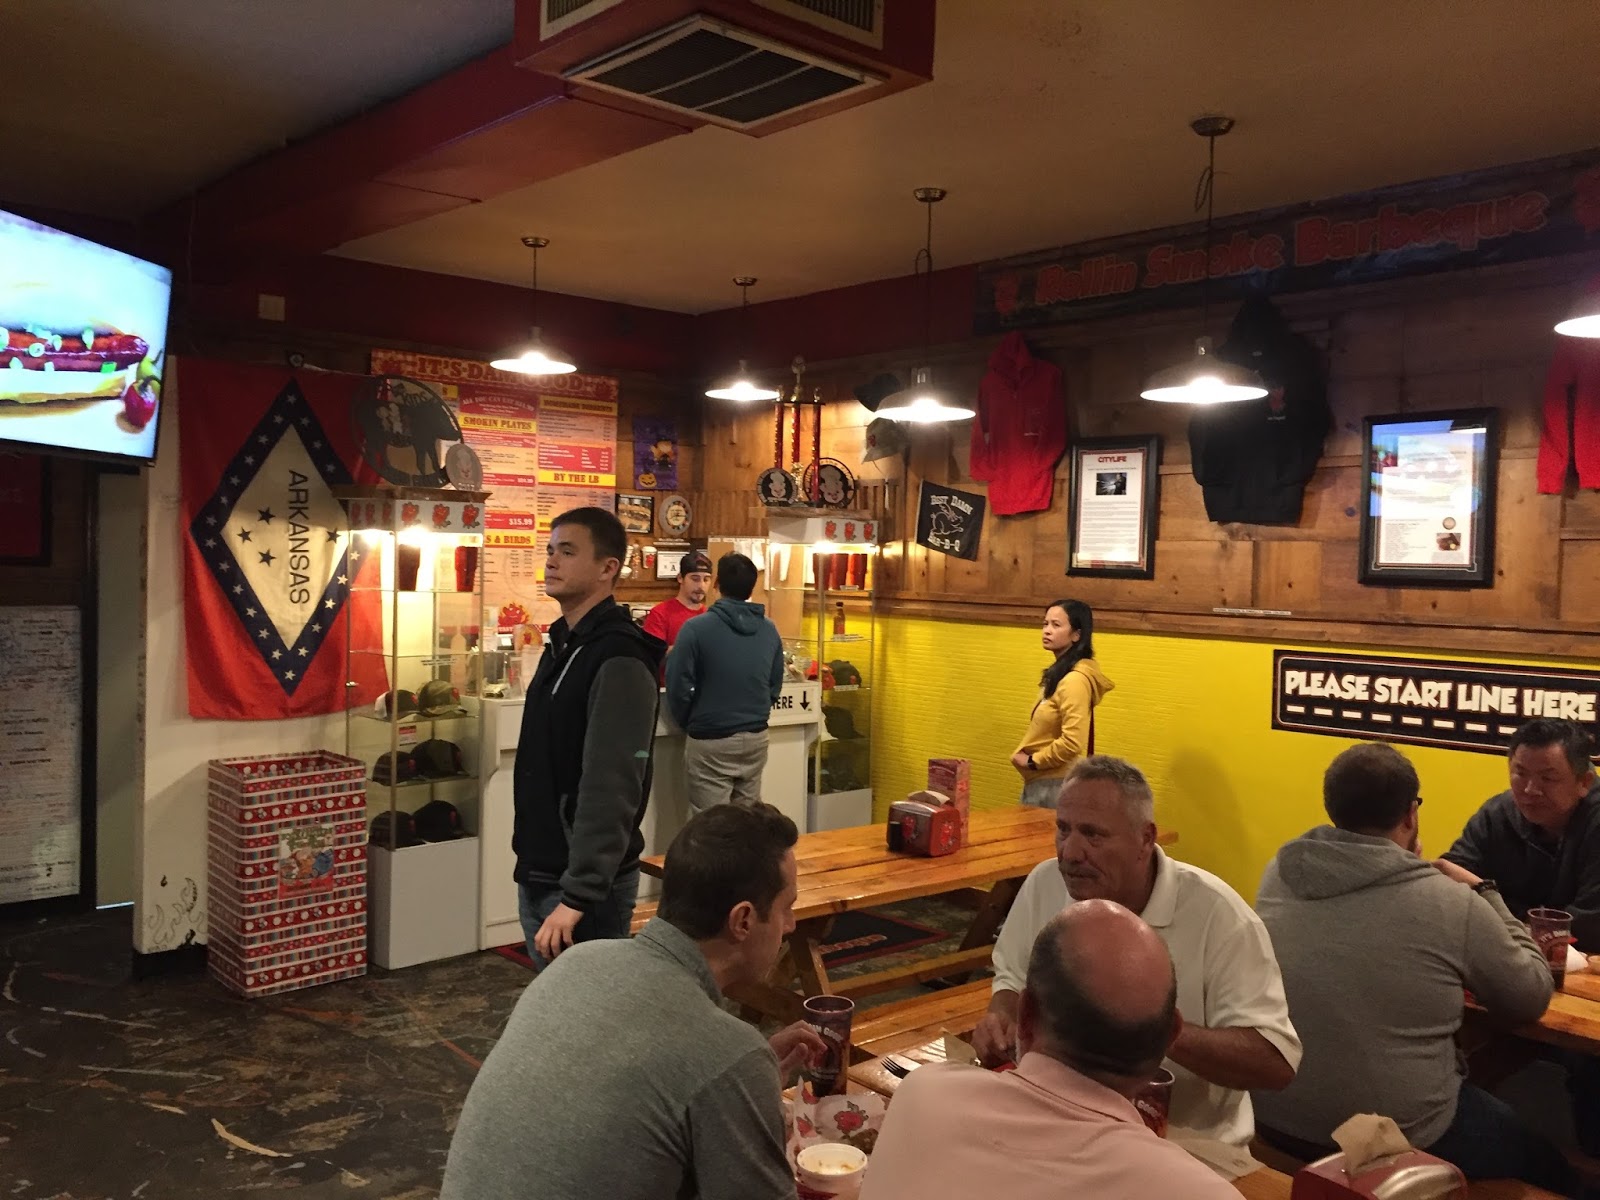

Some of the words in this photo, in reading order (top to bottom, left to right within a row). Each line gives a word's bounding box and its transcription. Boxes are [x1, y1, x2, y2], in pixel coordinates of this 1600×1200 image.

[1034, 255, 1137, 306] Rollin
[1143, 231, 1285, 289] Smoke
[1293, 191, 1551, 266] Barbeque
[418, 357, 462, 377] IT'S
[463, 416, 498, 427] SMOKIN
[500, 420, 532, 430] PLATES
[1098, 455, 1127, 463] CITYLIFE
[553, 472, 566, 481] BY
[568, 474, 586, 482] THE
[588, 475, 600, 484] LB
[508, 518, 533, 526] $15.99
[288, 469, 311, 606] ARKANSAS
[503, 535, 532, 544] BIRDS
[1284, 670, 1371, 701] PLEASE
[1374, 676, 1453, 709] START
[1457, 683, 1517, 714] LINE
[1522, 688, 1597, 722] HERE
